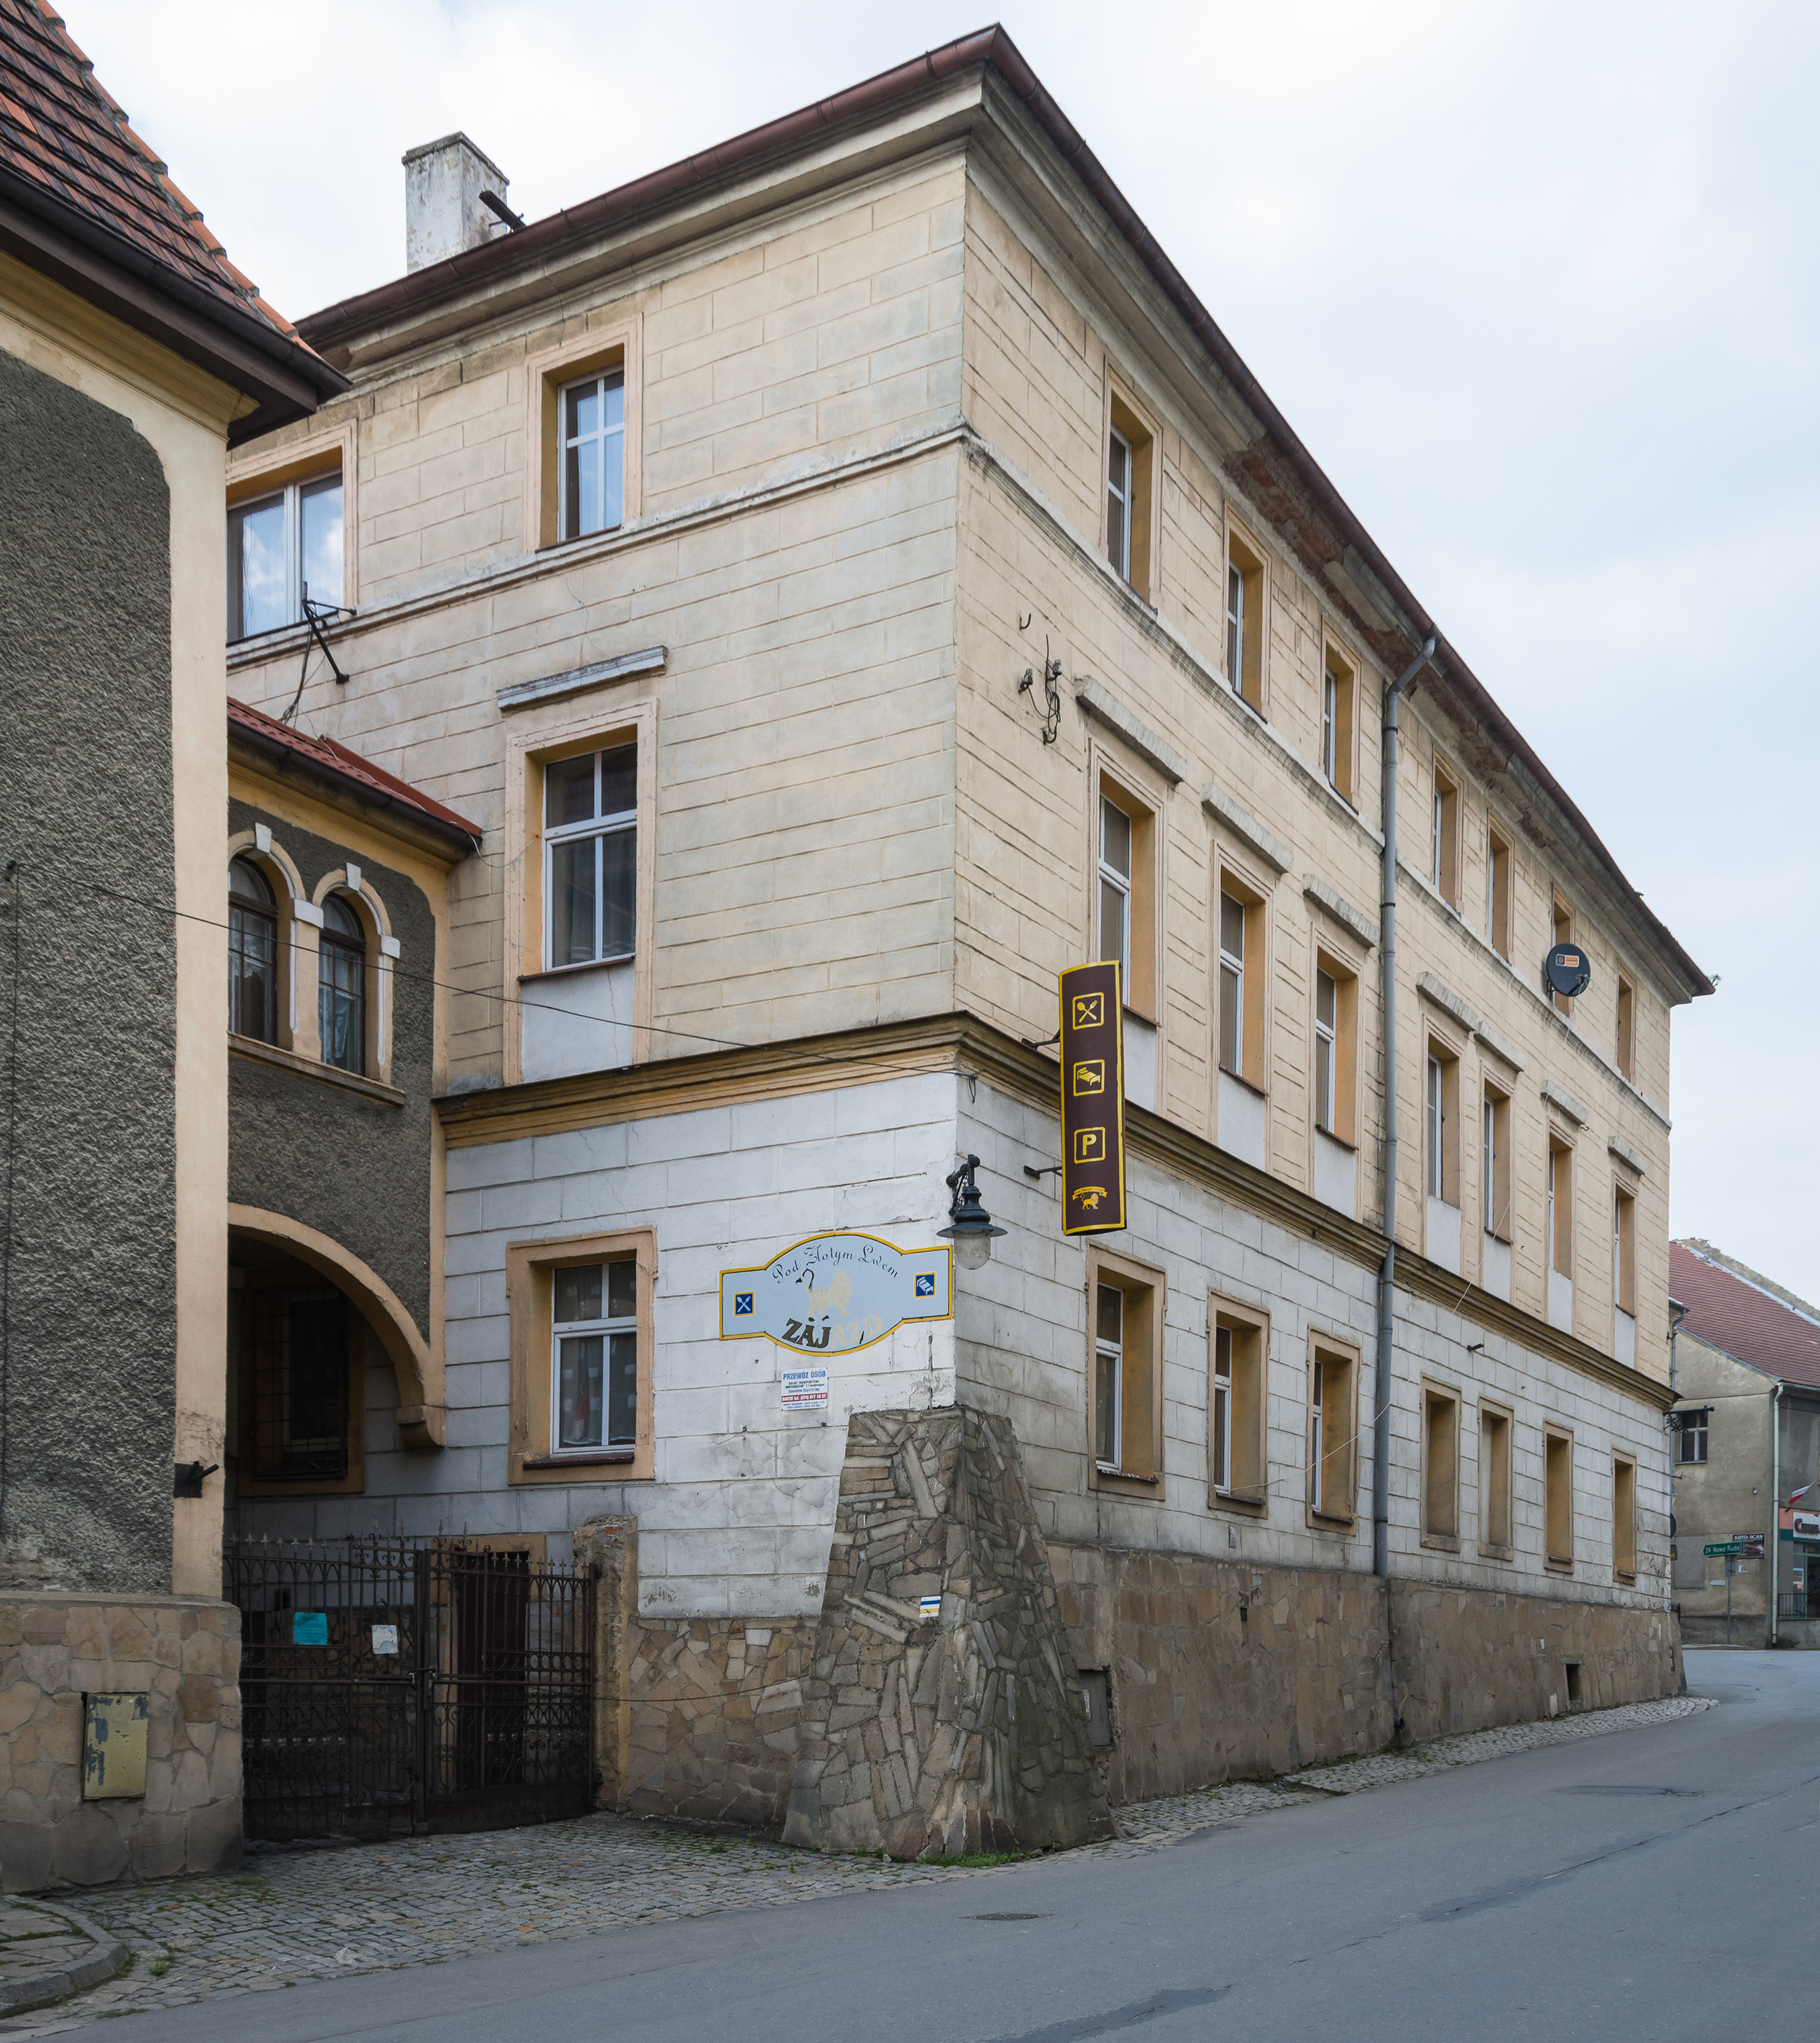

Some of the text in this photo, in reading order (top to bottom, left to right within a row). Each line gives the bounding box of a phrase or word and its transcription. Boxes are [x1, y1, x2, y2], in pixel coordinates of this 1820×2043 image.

[1082, 1134, 1097, 1156] P
[772, 1260, 801, 1284] Pod
[858, 1245, 900, 1278] Lwem
[783, 1369, 826, 1380] PRZEWÓZ OSÓB
